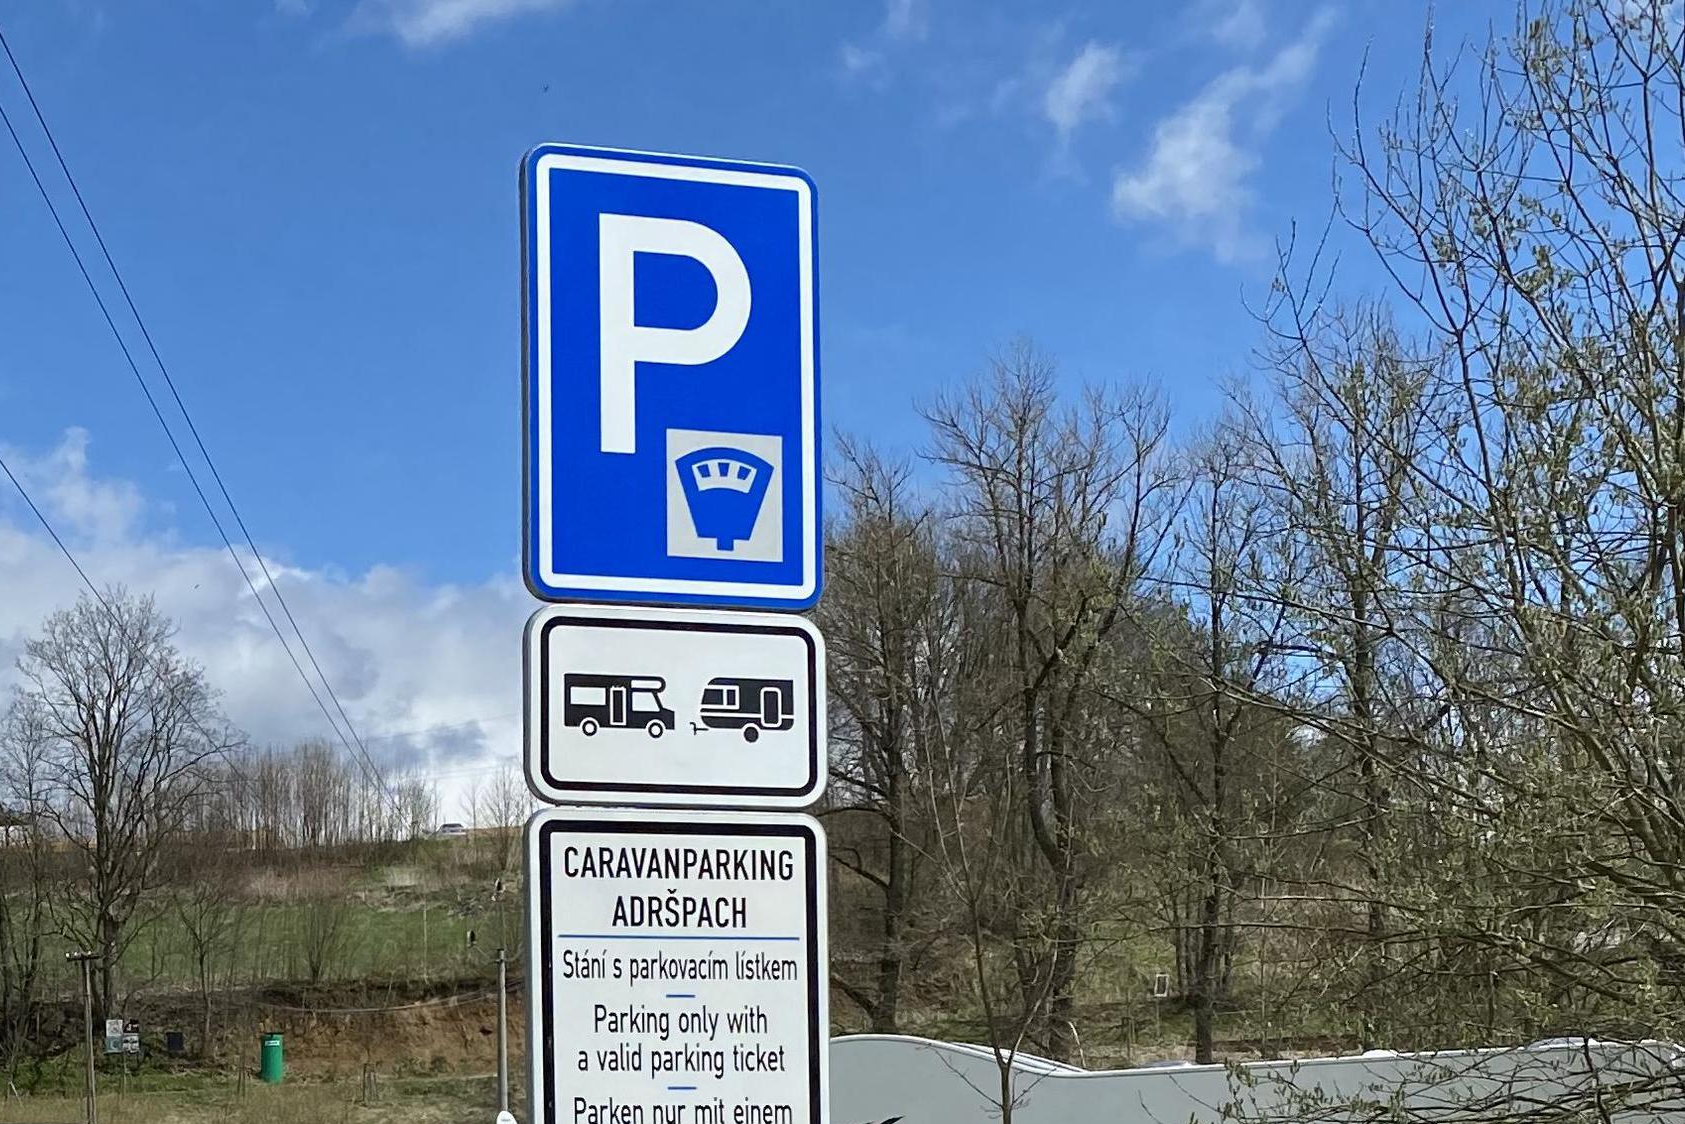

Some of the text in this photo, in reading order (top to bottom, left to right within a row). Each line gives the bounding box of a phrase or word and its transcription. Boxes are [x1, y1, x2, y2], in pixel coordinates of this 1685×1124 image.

[599, 213, 752, 454] P
[564, 846, 794, 881] CARAVANPARKING
[611, 888, 747, 929] ADRŠPACH
[562, 948, 798, 988] Stání s parkovacím lístkem
[594, 1003, 768, 1042] Parking only with
[577, 1042, 786, 1080] a valid parking ticket
